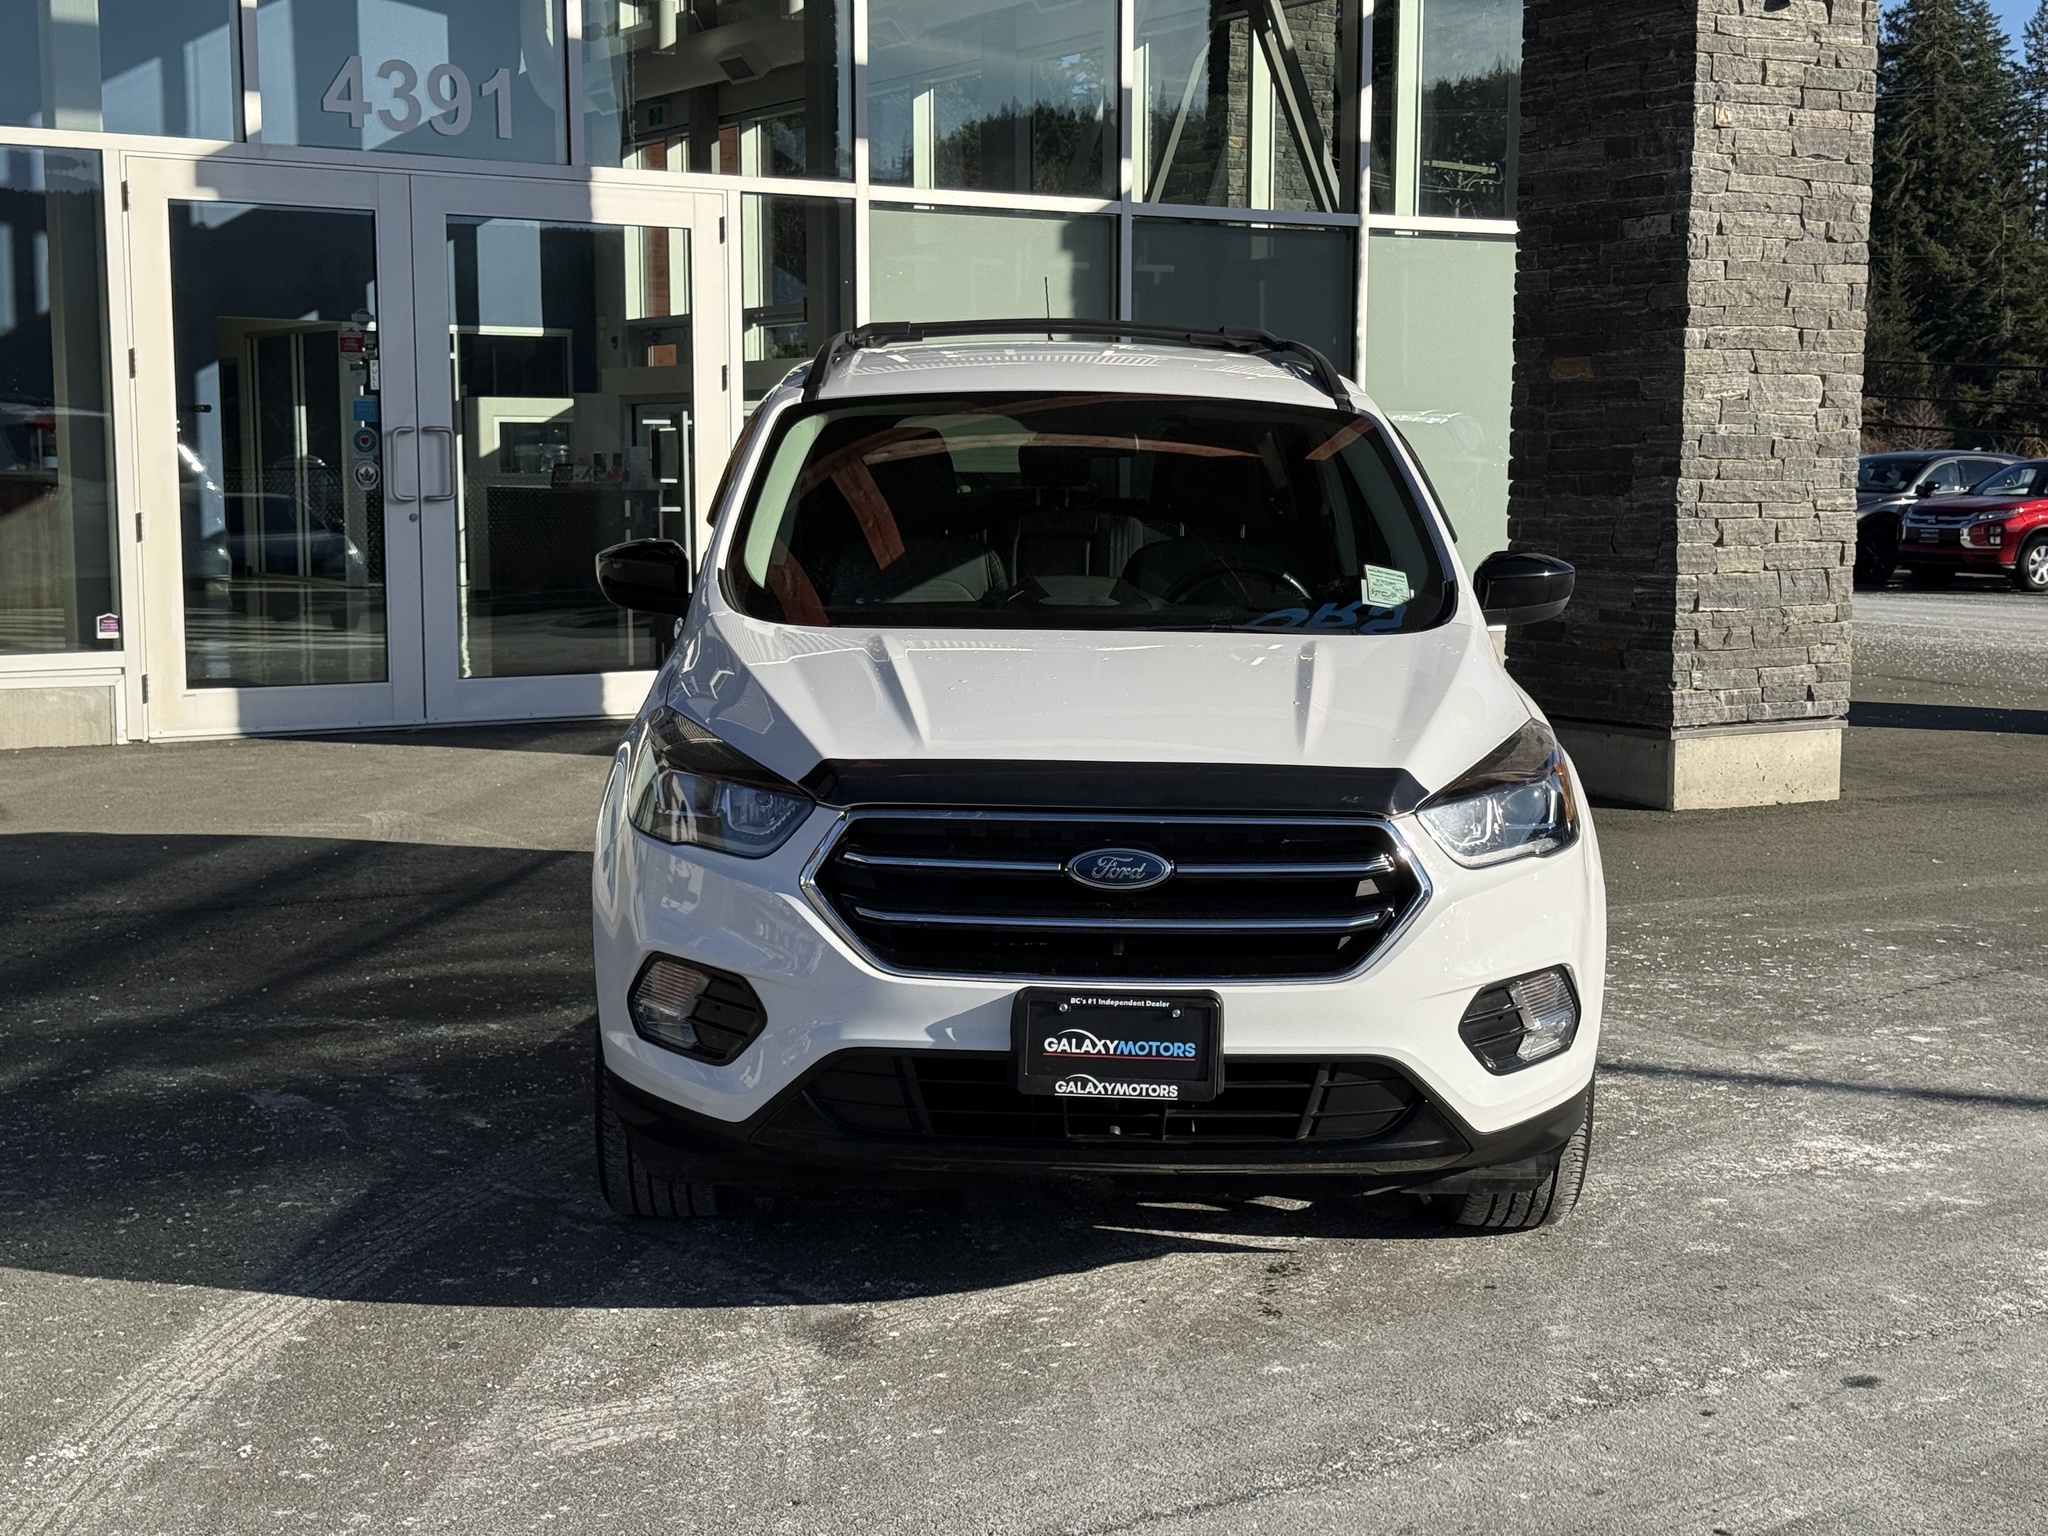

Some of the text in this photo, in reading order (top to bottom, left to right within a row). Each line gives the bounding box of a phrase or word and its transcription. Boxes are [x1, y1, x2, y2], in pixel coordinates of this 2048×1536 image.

[321, 55, 512, 139] 4391
[1091, 856, 1147, 879] Ford
[1070, 997, 1086, 1005] BC's
[1098, 998, 1145, 1007] Independent
[1146, 1000, 1170, 1008] Dealer
[1043, 1034, 1196, 1057] GALAXYMOTORS
[1055, 1079, 1178, 1097] GALAXYMOTORS
